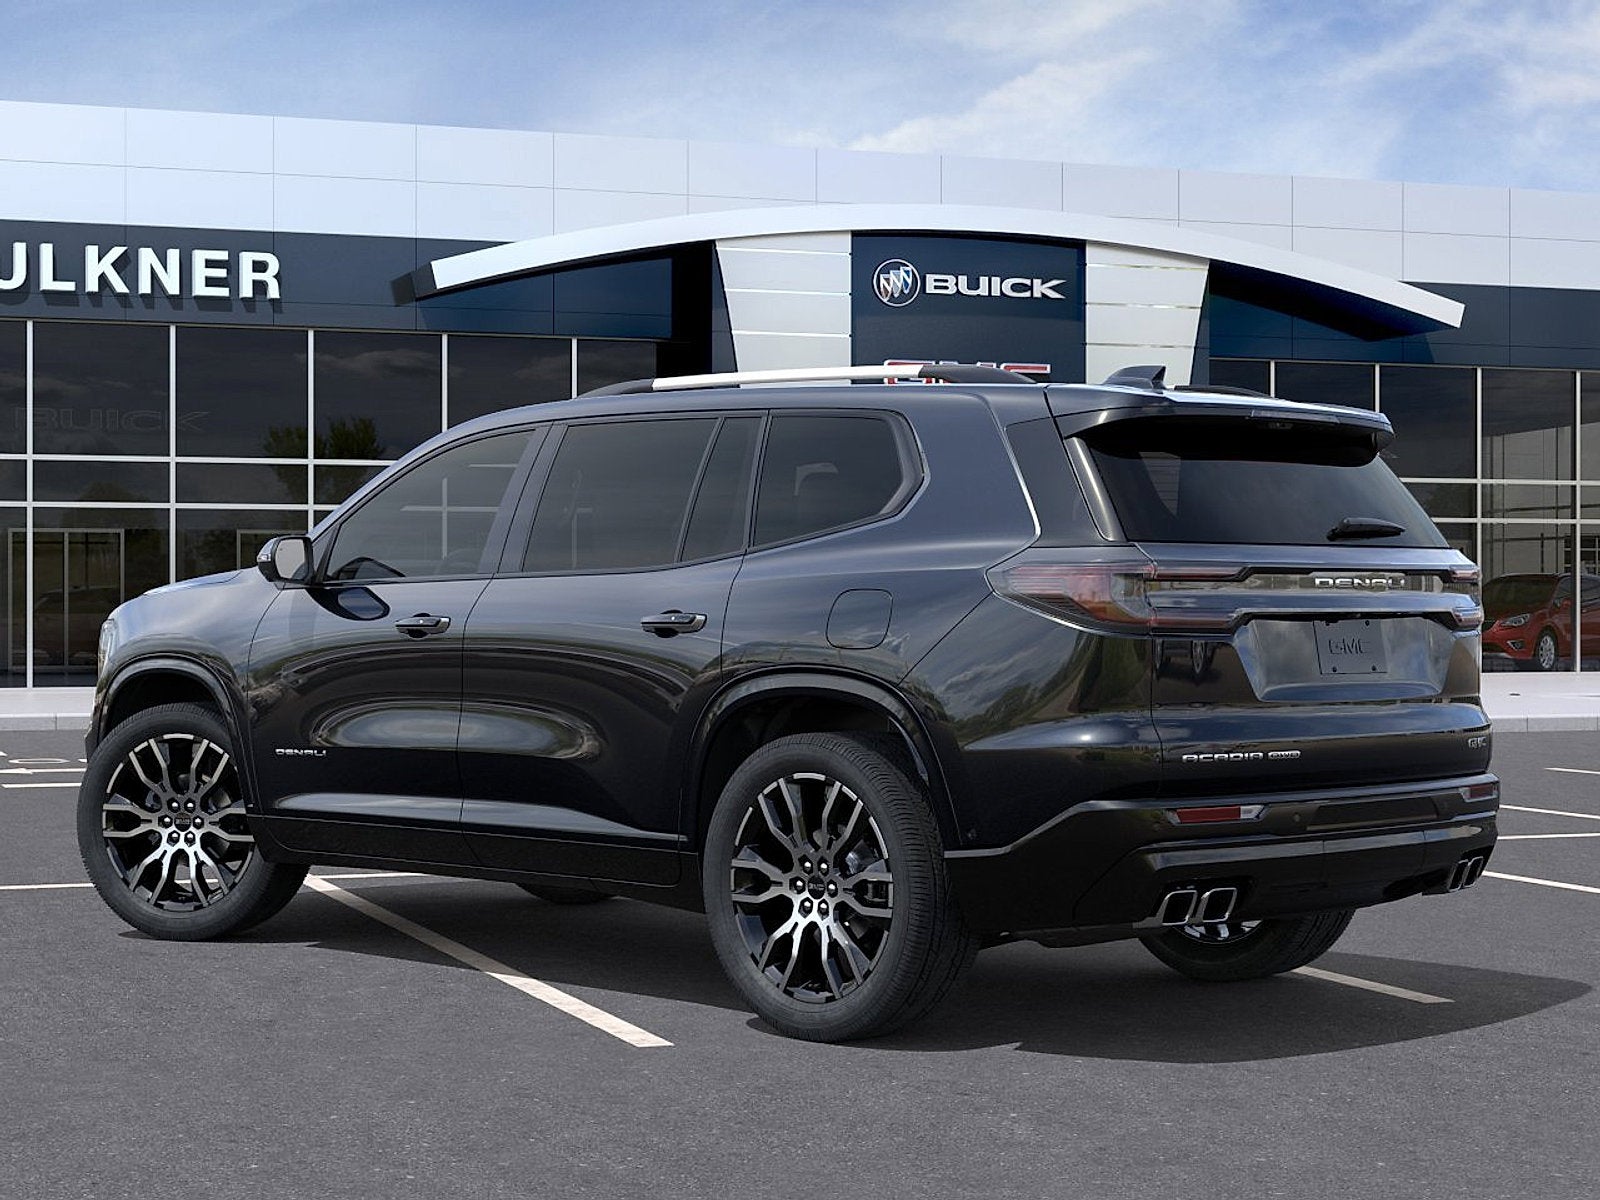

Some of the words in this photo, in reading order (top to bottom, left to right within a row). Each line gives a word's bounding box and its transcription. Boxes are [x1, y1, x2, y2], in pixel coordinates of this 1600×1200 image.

[925, 273, 1067, 299] BUICK
[1314, 577, 1405, 588] DENALI
[275, 748, 327, 758] DENALI
[1182, 752, 1264, 764] ACADIA
